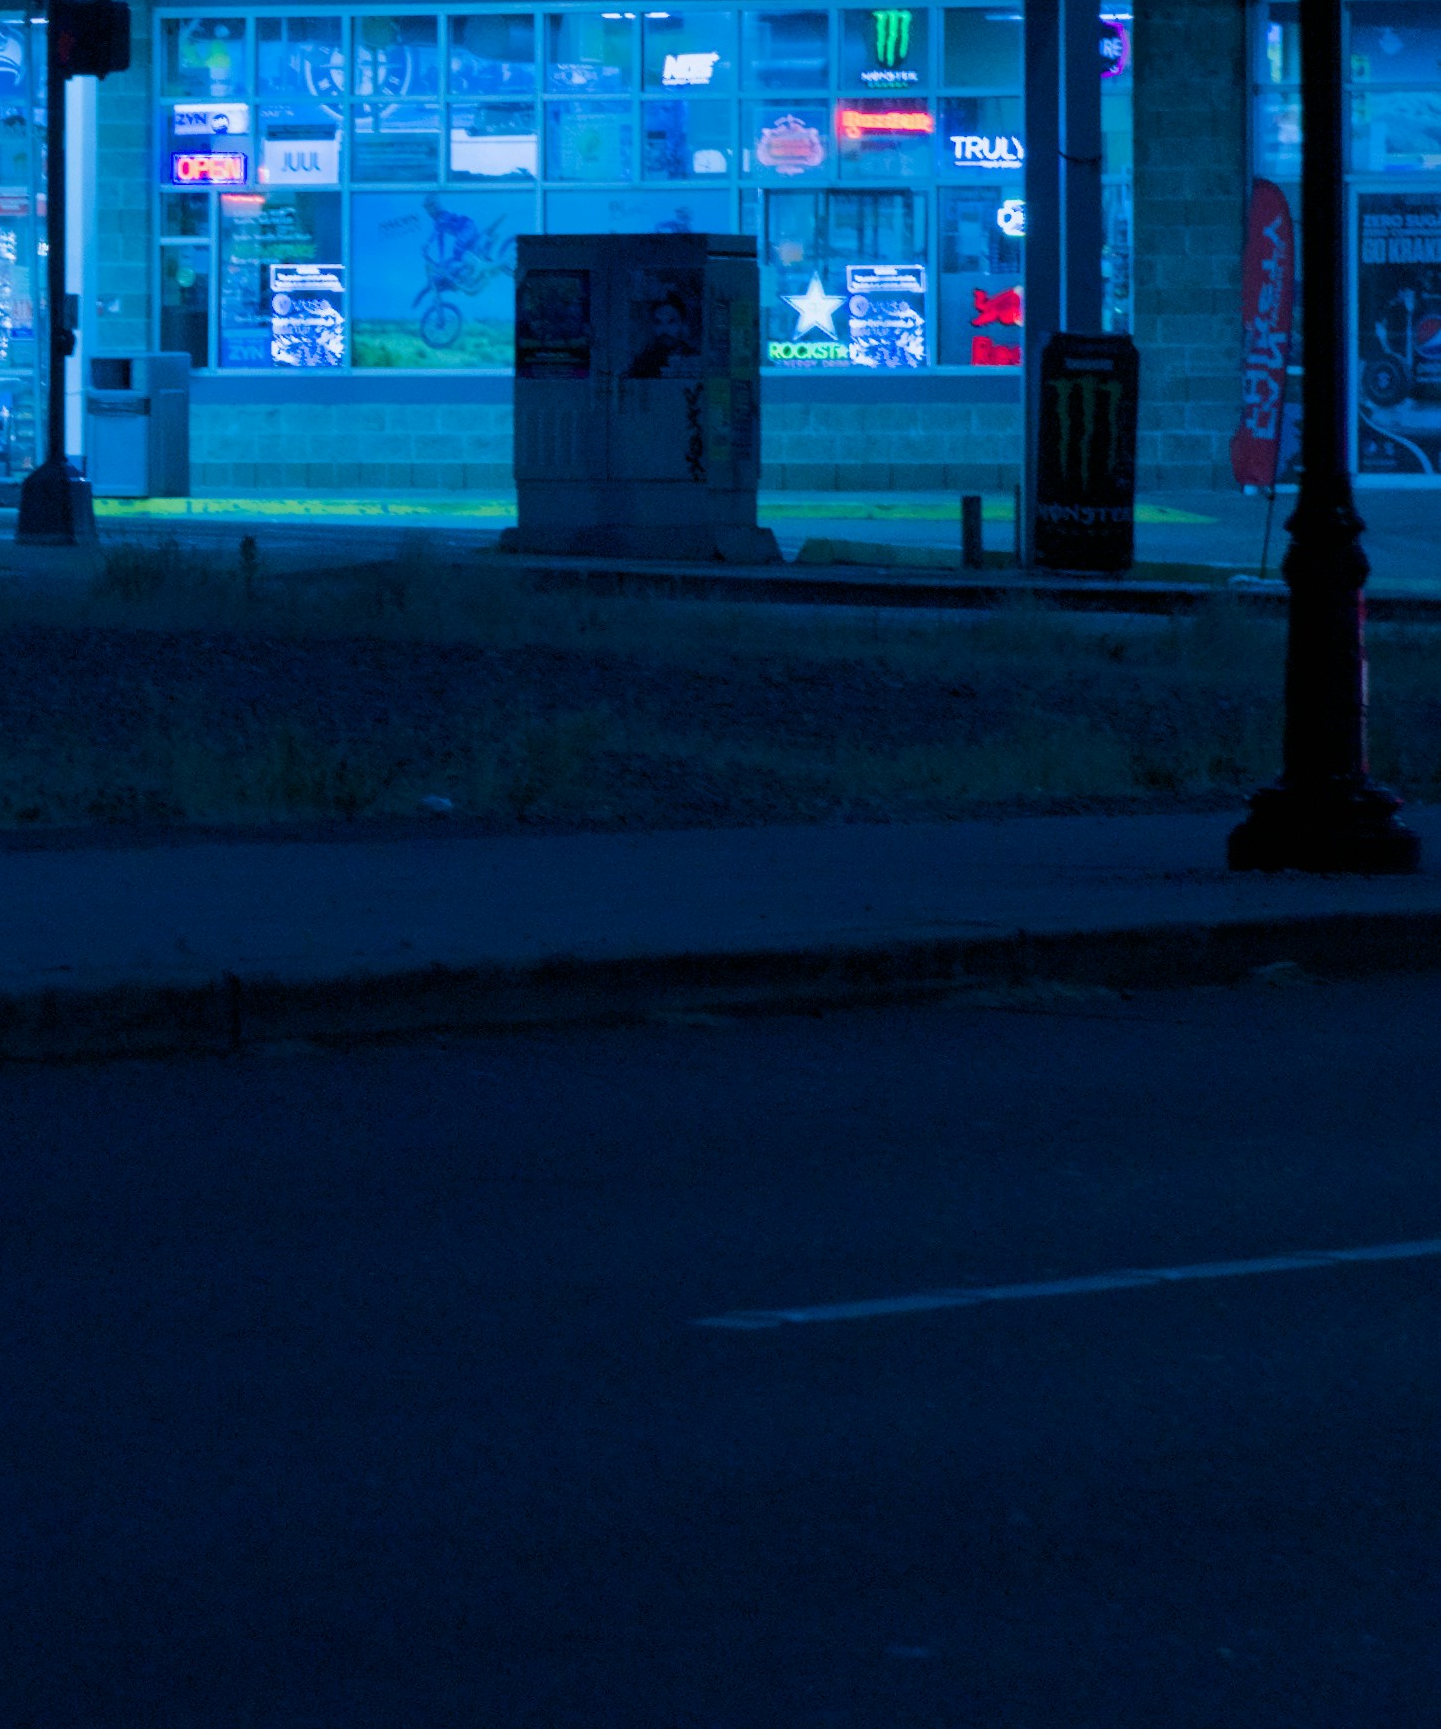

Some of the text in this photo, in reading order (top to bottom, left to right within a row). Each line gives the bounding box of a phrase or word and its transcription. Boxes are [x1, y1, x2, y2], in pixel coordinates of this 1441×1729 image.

[175, 113, 207, 125] ZYN
[176, 155, 243, 181] OPEN
[282, 151, 321, 172] JUUL
